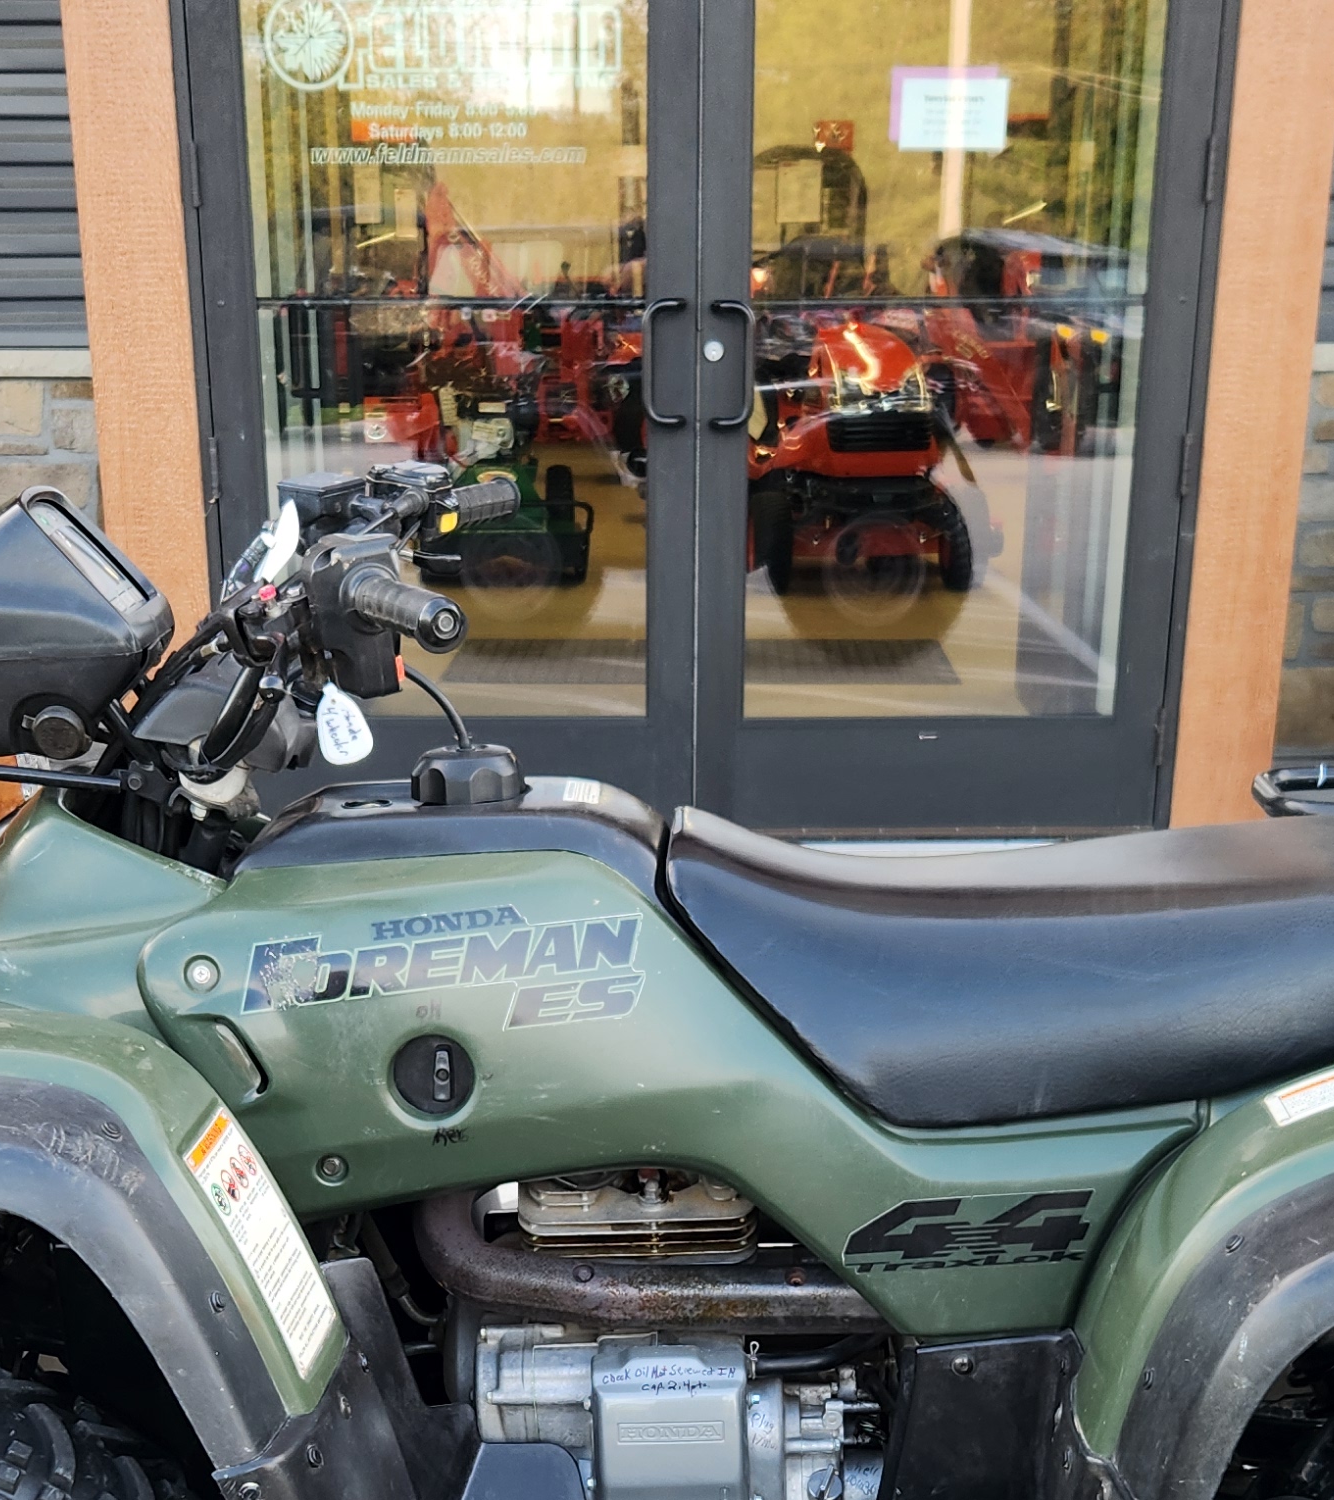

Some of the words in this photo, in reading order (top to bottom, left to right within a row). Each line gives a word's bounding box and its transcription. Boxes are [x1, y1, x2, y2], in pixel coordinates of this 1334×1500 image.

[366, 74, 437, 89] SALES
[368, 122, 444, 142] Saturdays
[310, 142, 587, 165] www.feldmannsales.com
[371, 905, 524, 941] HONDA
[240, 913, 643, 1015] FOREMAN
[503, 971, 646, 1032] ES
[620, 1425, 721, 1441] HONDA
